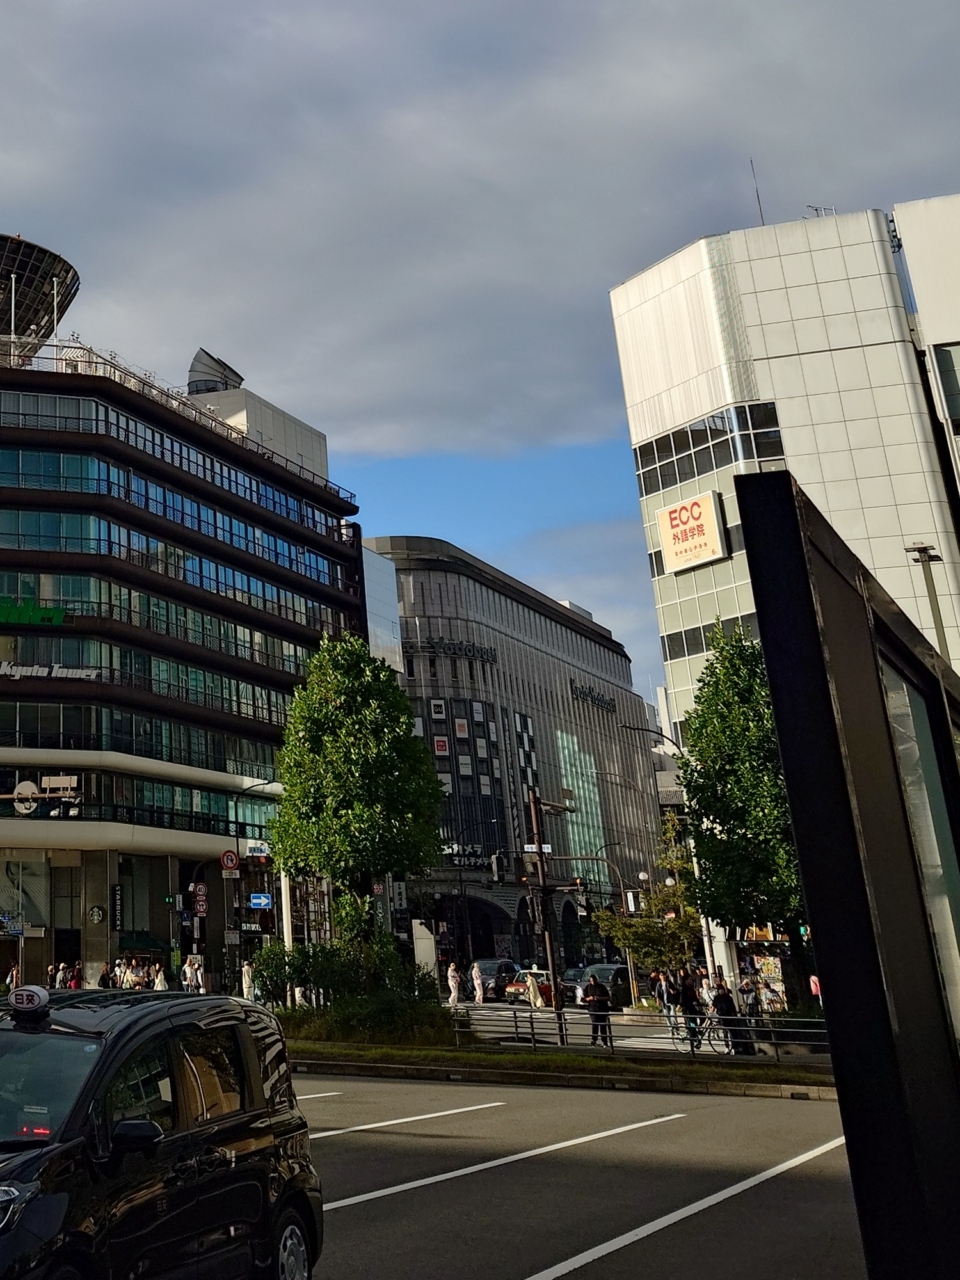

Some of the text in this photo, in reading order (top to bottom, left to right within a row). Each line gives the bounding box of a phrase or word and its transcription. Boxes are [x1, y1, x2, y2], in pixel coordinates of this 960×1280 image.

[668, 501, 702, 529] ECC
[672, 523, 706, 545] 外語学院
[51, 663, 101, 680] Tower
